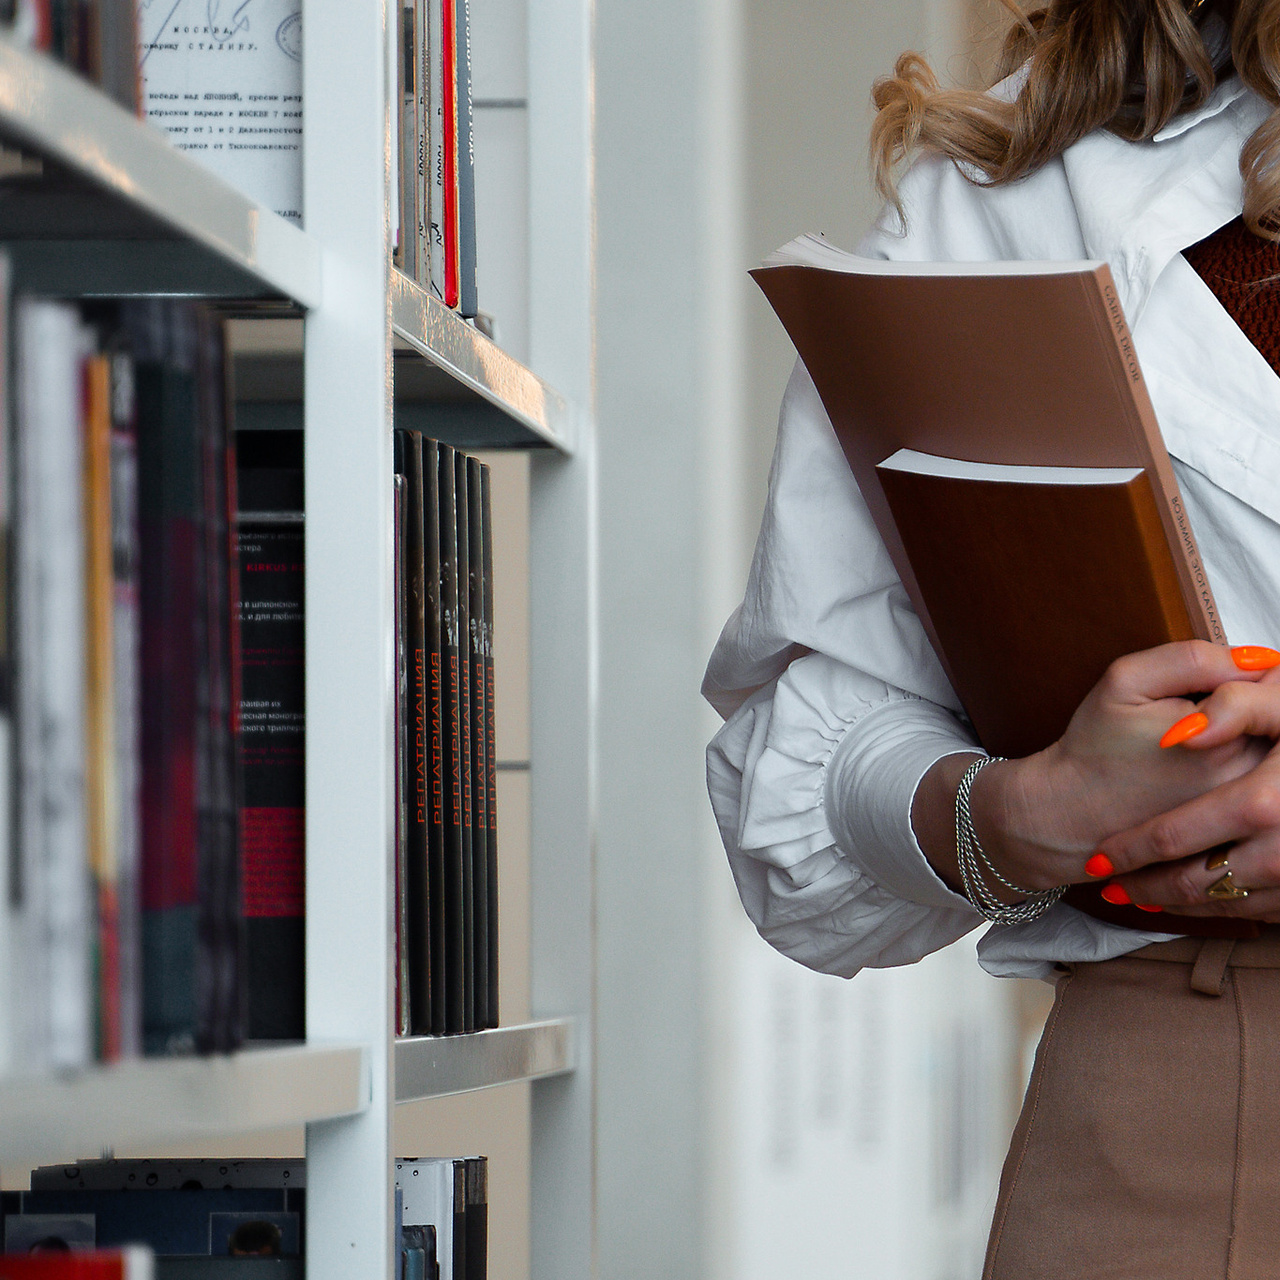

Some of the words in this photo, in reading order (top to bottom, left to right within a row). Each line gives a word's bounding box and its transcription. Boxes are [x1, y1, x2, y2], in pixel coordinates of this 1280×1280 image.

[415, 648, 425, 822] РЕПАТРИАЦИЯ
[431, 652, 441, 824] РЕПАТРИАЦИЯ
[450, 655, 460, 825] РЕПАТРИАЦИЯ
[475, 663, 486, 829] РЕПАТРИАЦИЯ
